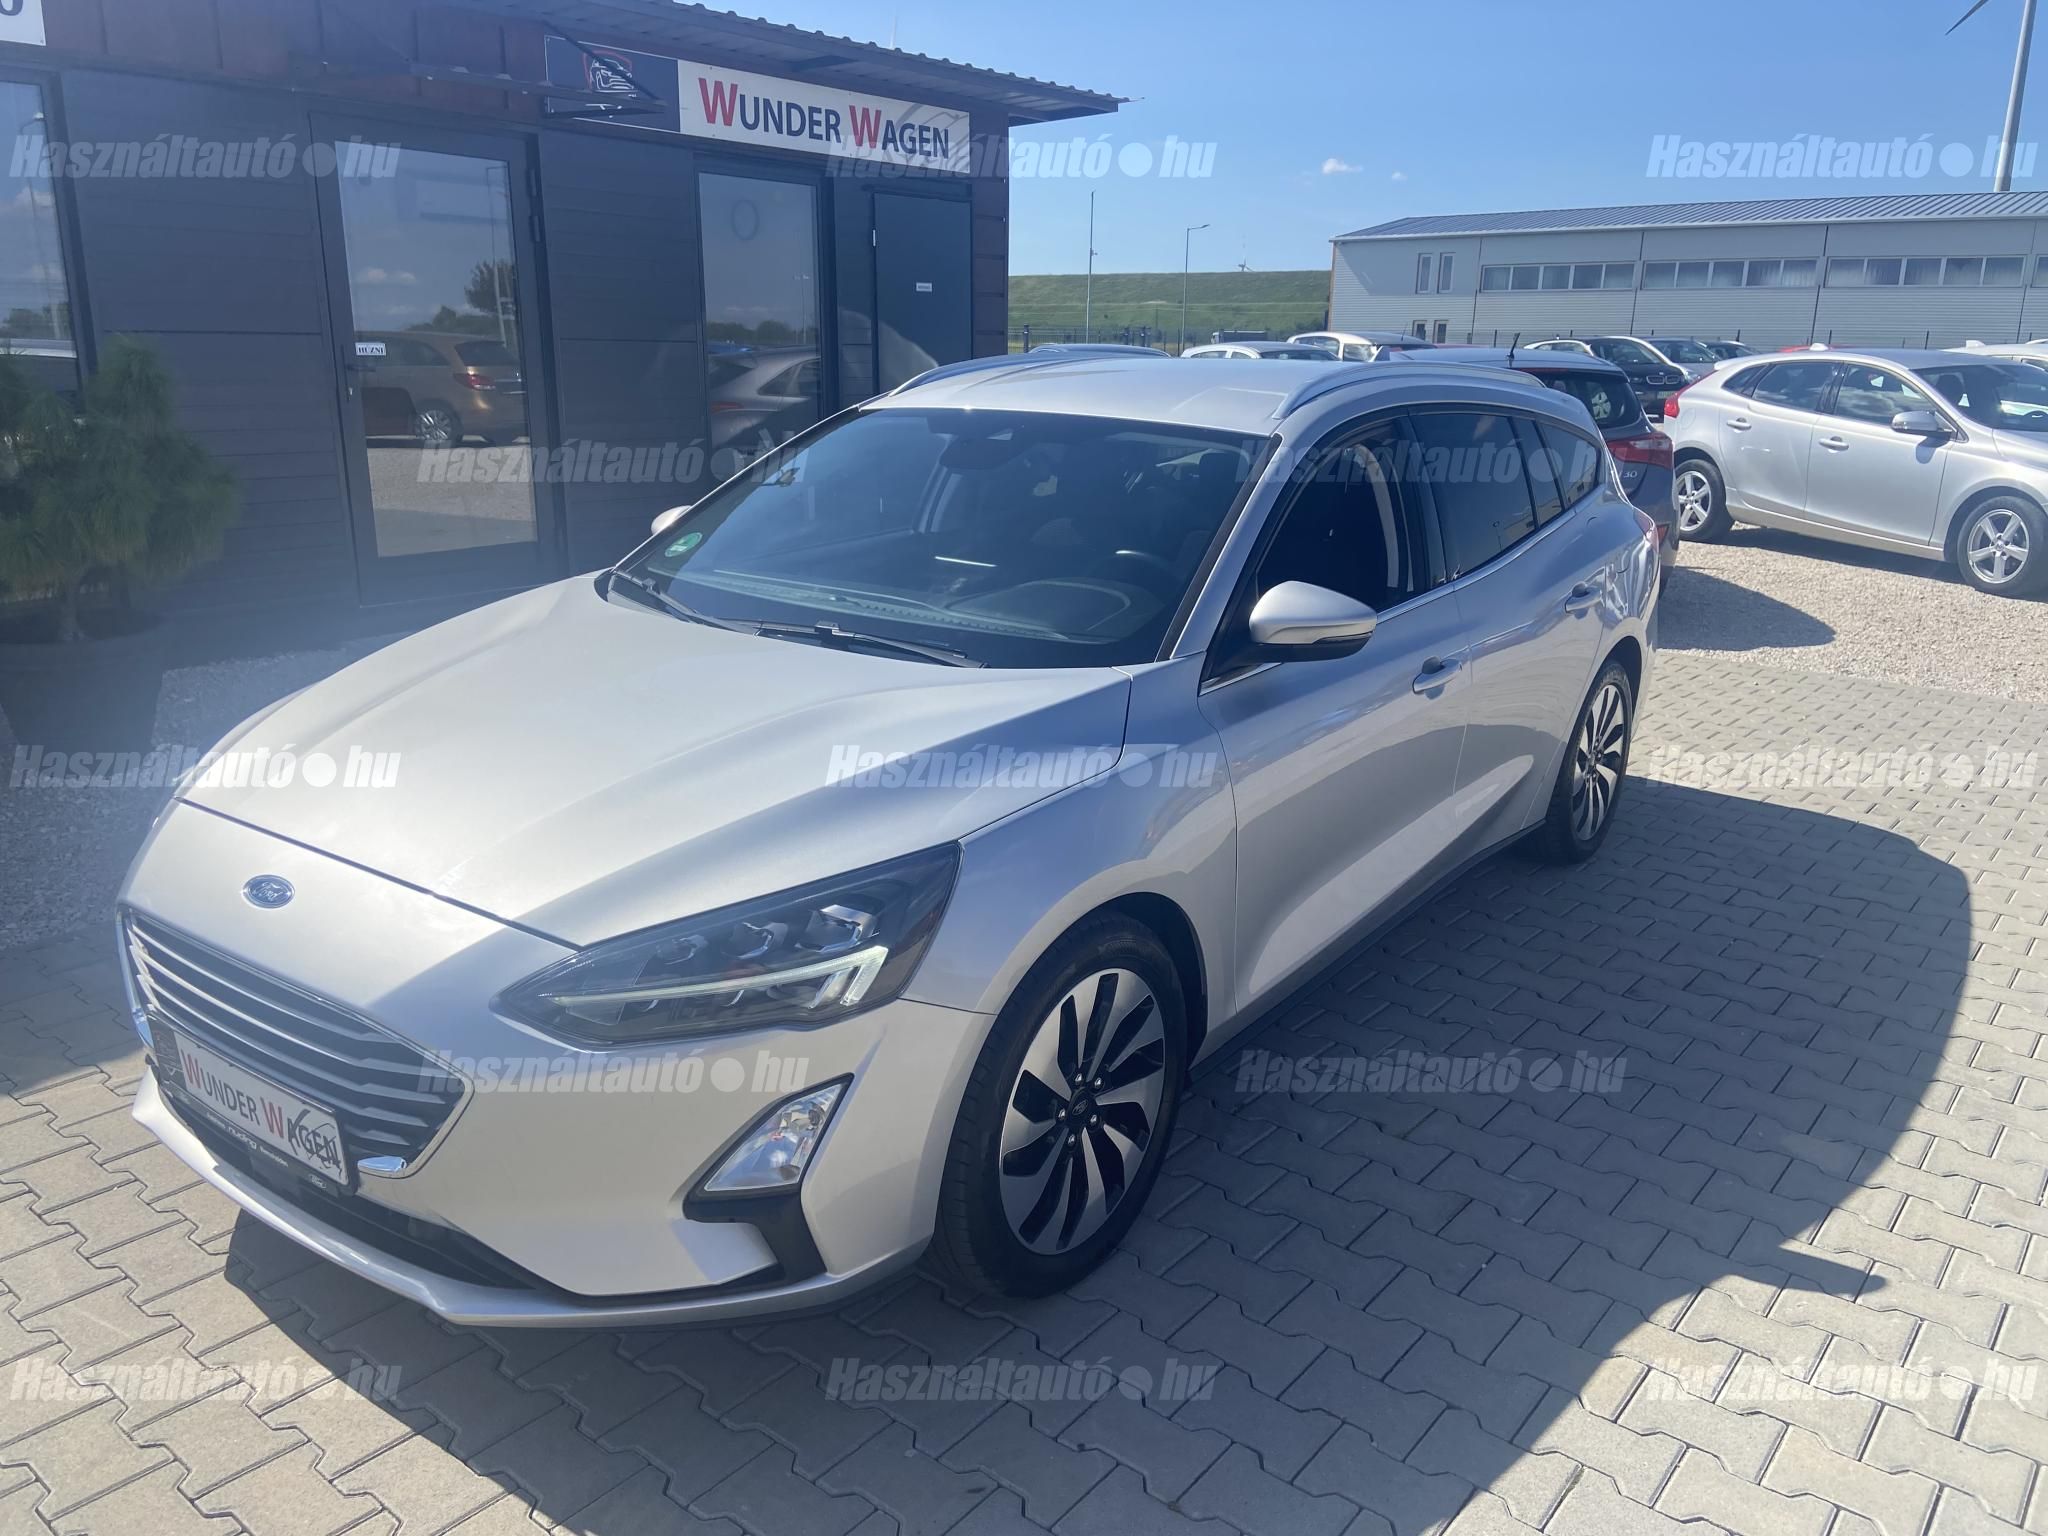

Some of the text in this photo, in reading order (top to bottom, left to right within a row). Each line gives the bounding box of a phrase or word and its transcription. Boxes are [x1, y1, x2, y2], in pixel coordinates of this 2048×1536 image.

[698, 77, 949, 159] WUNDER WAGEN
[181, 1050, 260, 1126] WUNDER
